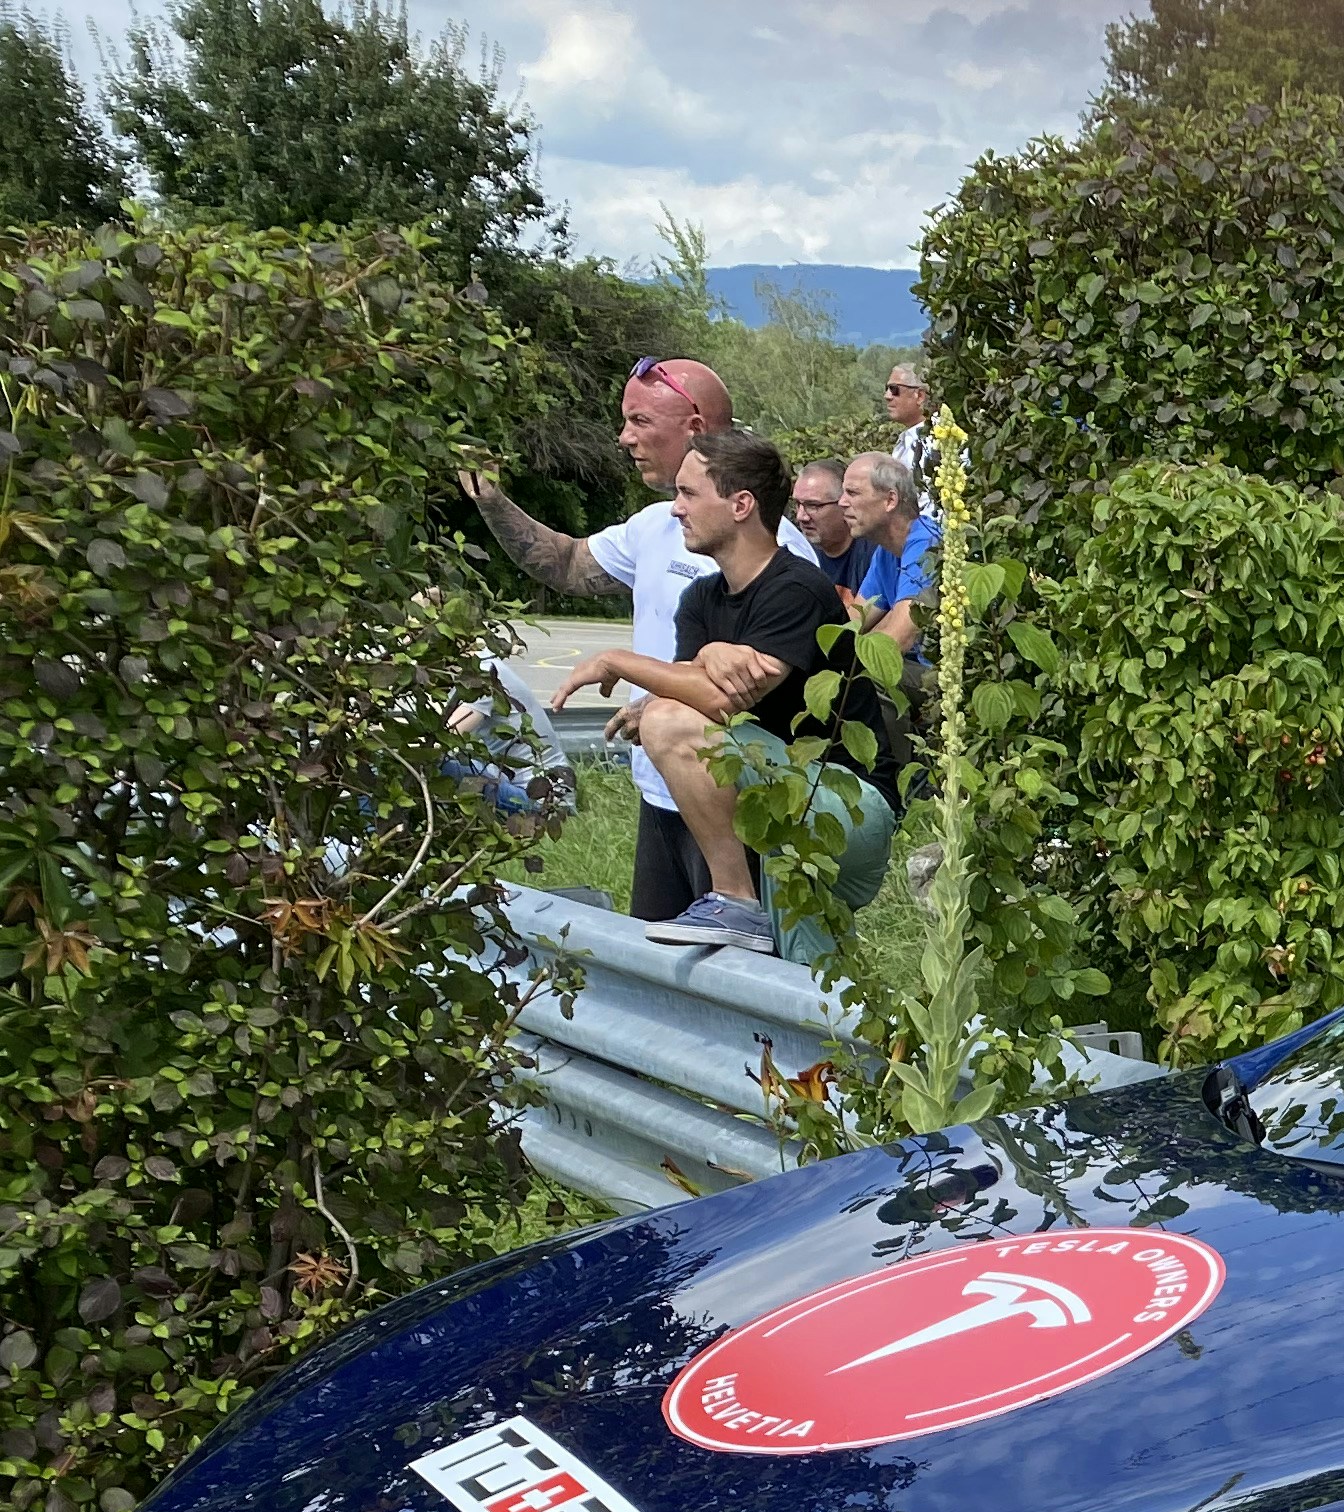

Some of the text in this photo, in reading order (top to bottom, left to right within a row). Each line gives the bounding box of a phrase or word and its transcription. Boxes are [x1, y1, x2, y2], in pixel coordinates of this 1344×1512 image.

[996, 1239, 1190, 1323] TESLA OWNERS
[701, 1372, 814, 1439] HELVETIA
